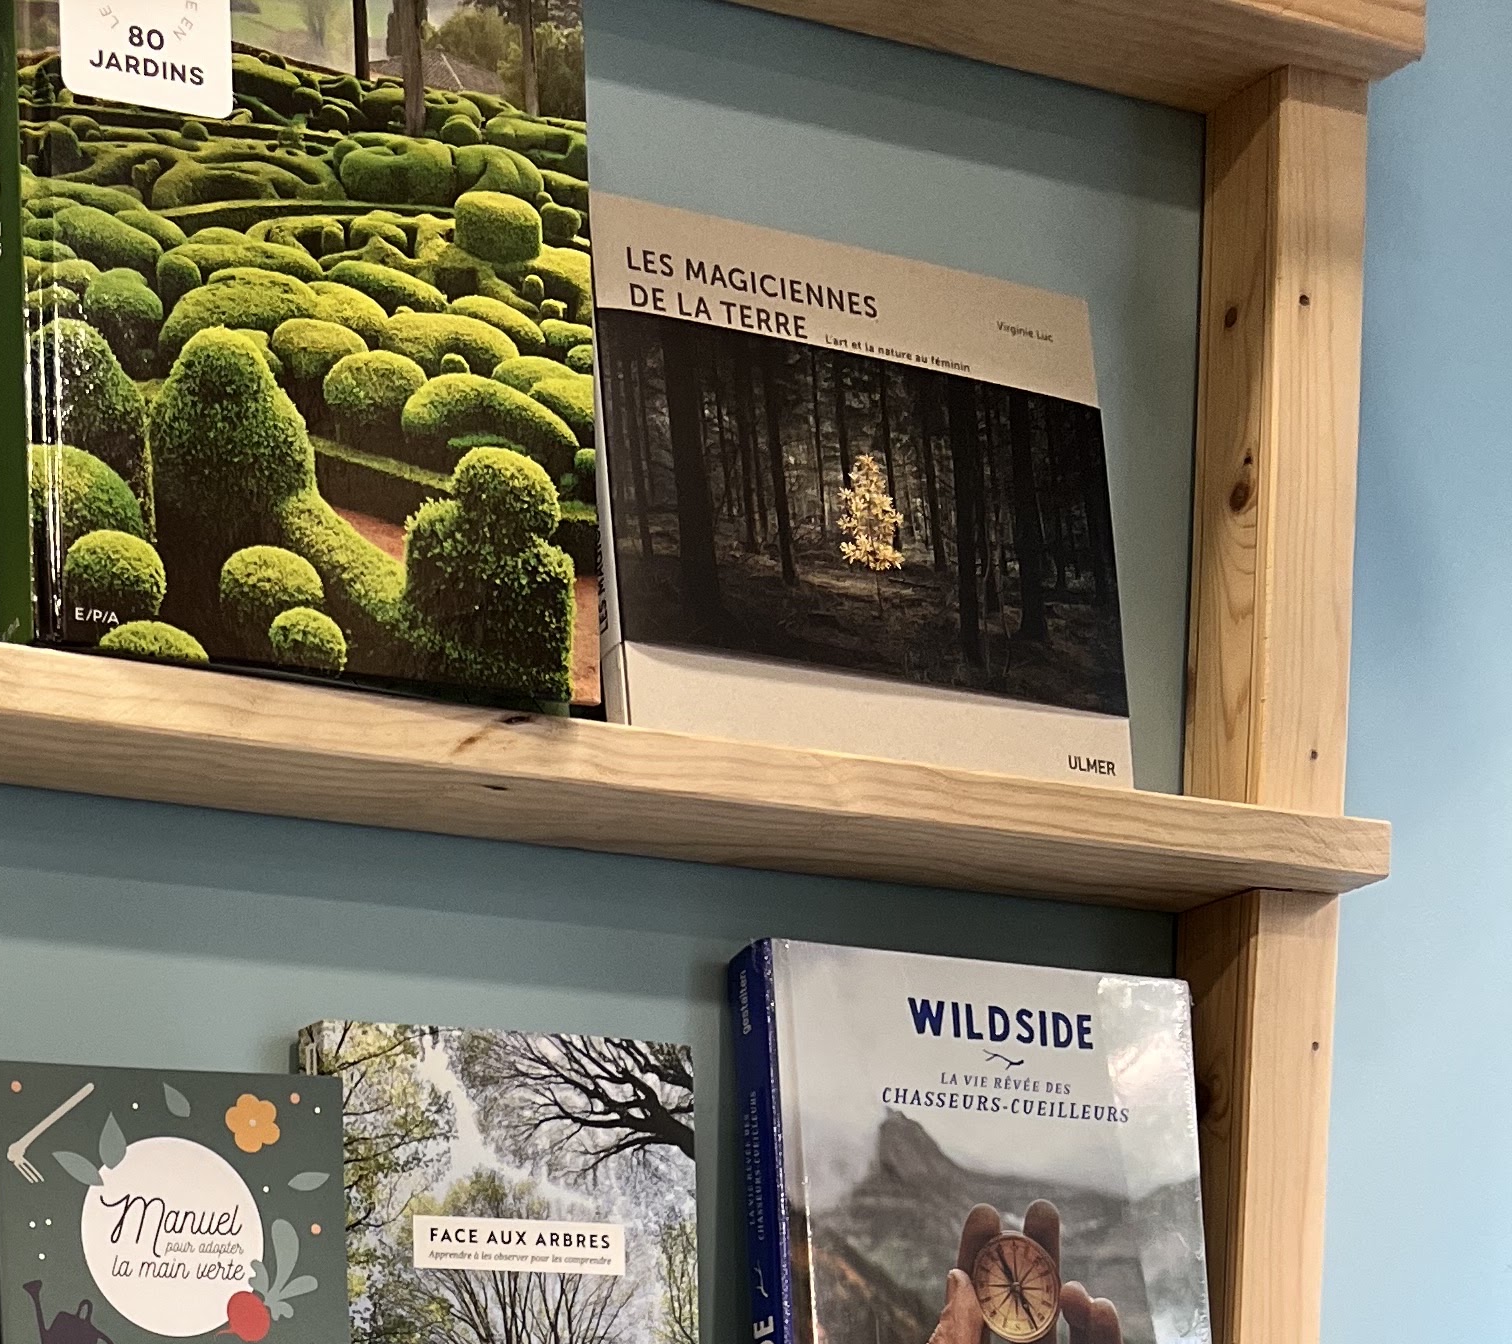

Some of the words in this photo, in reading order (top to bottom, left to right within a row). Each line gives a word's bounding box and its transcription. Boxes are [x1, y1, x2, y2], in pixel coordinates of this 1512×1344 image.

[127, 25, 165, 51] 80
[89, 50, 205, 86] JARDINS
[626, 246, 674, 278] LES
[686, 257, 878, 319] MAGICIENNES
[629, 282, 666, 313] DE
[678, 292, 711, 322] LA
[720, 300, 809, 341] TERRE
[996, 320, 1033, 341] Virginie
[1036, 329, 1054, 344] Luc
[824, 334, 848, 350] L'art
[852, 339, 862, 350] et
[865, 341, 875, 353] la
[878, 347, 912, 362] nature
[915, 353, 928, 365] au
[931, 355, 971, 373] féminin
[75, 606, 120, 625] E/P/A
[1068, 753, 1117, 776] ULMER
[740, 969, 753, 1036] gestalten
[906, 997, 1094, 1050] WILDSIDE
[940, 1072, 958, 1086] LA
[964, 1075, 988, 1088] VIE
[994, 1075, 1040, 1093] RÊVÉE
[1045, 1081, 1071, 1095] DES
[882, 1087, 1130, 1124] CHASSEURS-CUEILLEURS
[100, 1194, 243, 1258] Manuel
[430, 1227, 478, 1244] FACE
[487, 1230, 527, 1246] AUX
[535, 1232, 610, 1249] ARBRES
[165, 1241, 195, 1257] pour
[199, 1241, 245, 1258] adopter
[112, 1255, 133, 1277] la
[139, 1257, 190, 1279] main
[197, 1259, 245, 1281] verte
